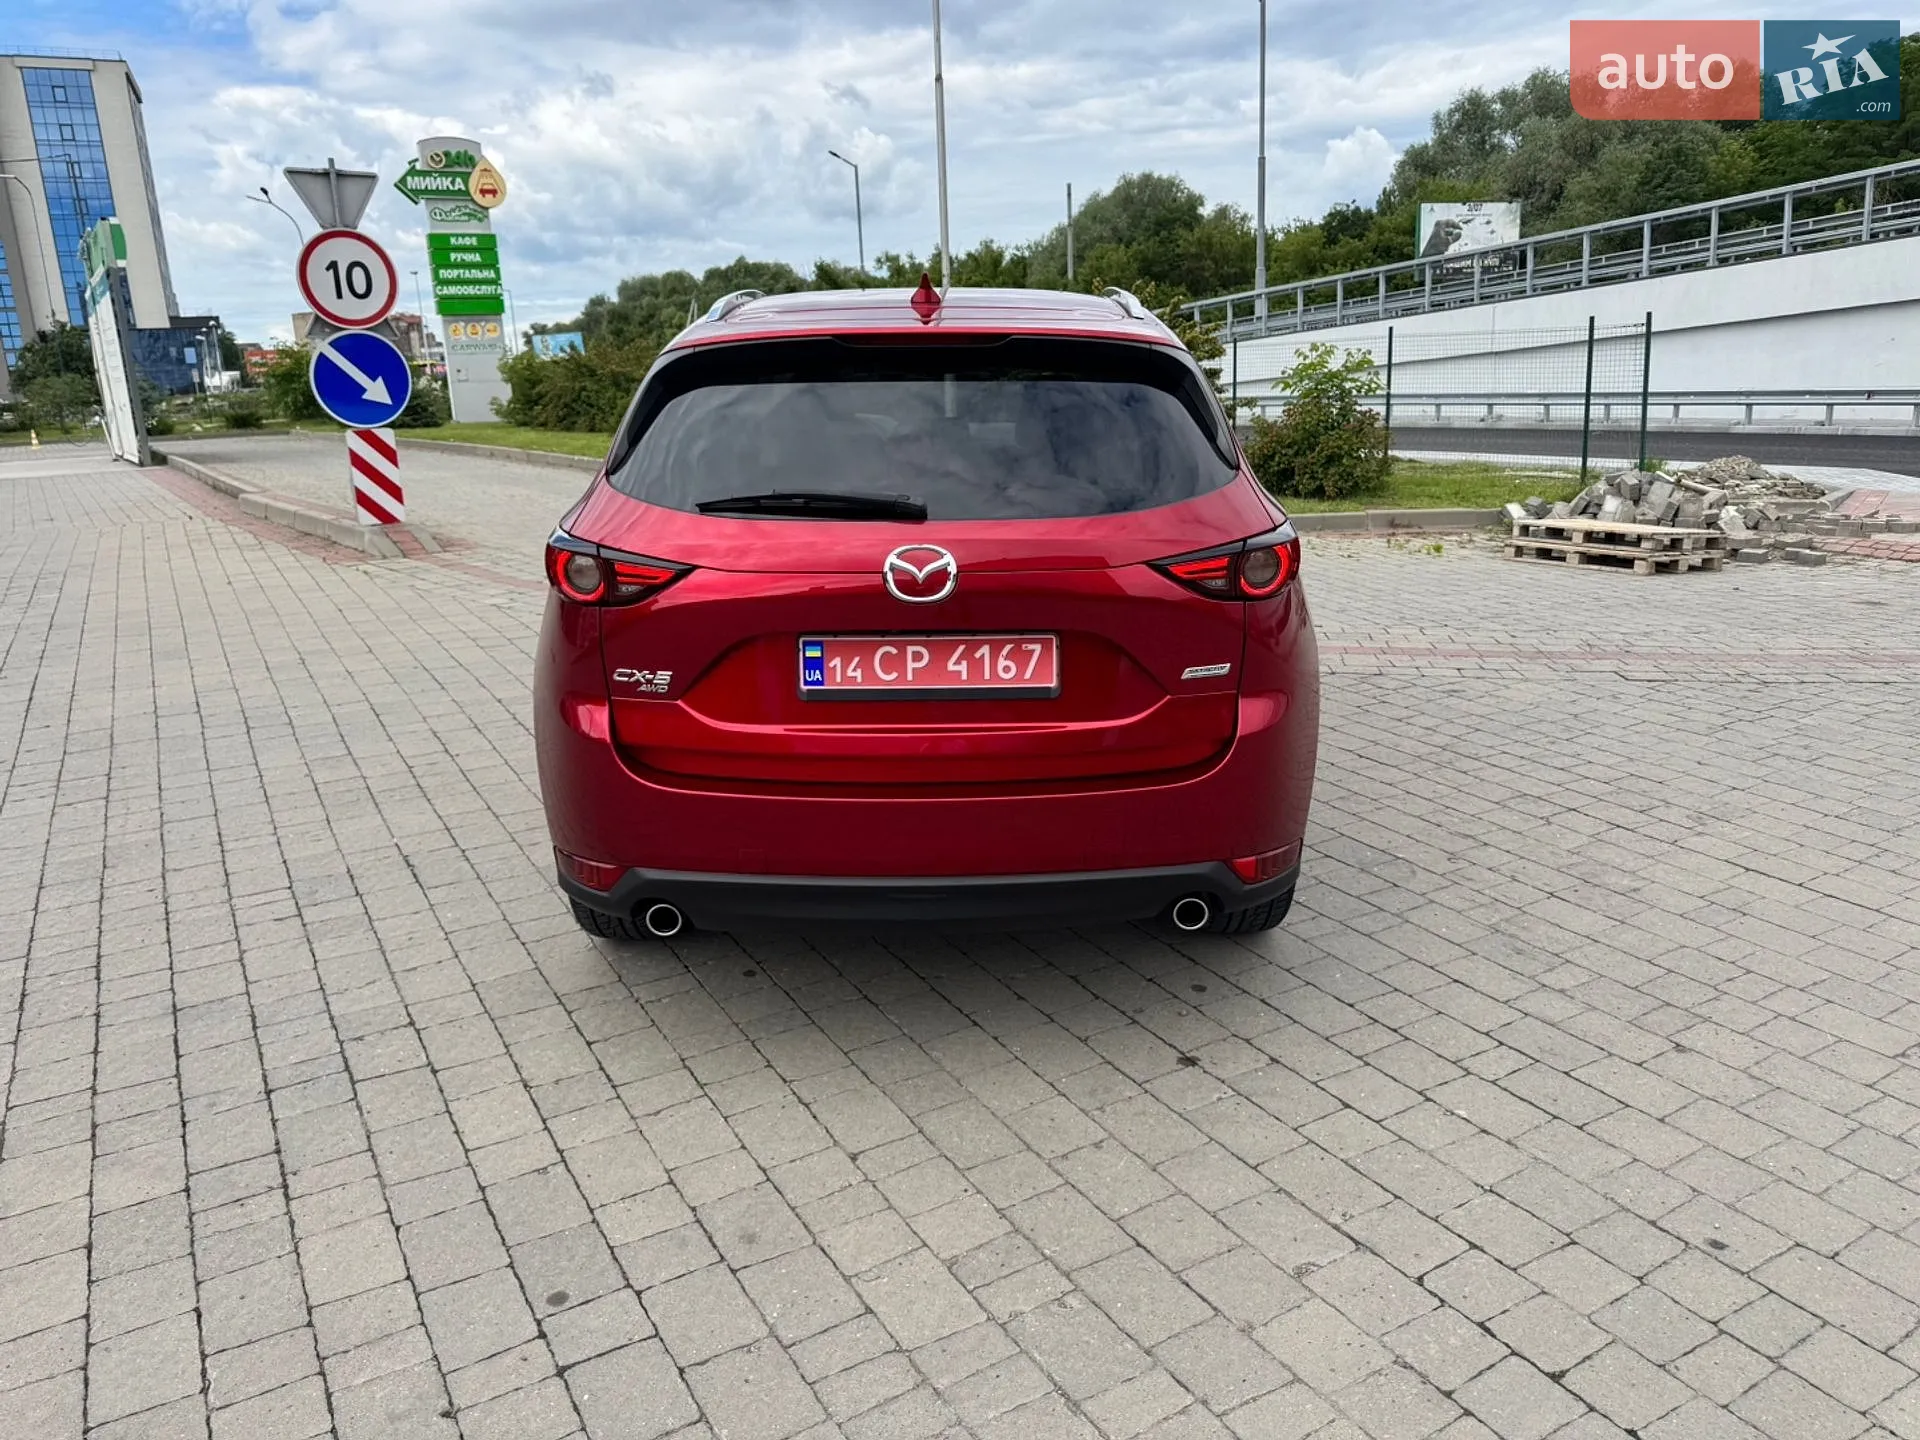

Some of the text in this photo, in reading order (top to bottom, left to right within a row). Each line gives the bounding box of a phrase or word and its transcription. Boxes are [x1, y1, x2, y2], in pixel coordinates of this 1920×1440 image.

[406, 173, 466, 191] МИЙКА
[449, 236, 478, 246] КАФЕ
[449, 252, 482, 262] РУЧНА
[325, 260, 373, 300] 10
[439, 269, 496, 279] ПОРТАЛЬНА
[946, 643, 1043, 682] 4167
[613, 668, 674, 685] CX-5
[805, 669, 823, 682] UA
[636, 684, 669, 693] AWD
